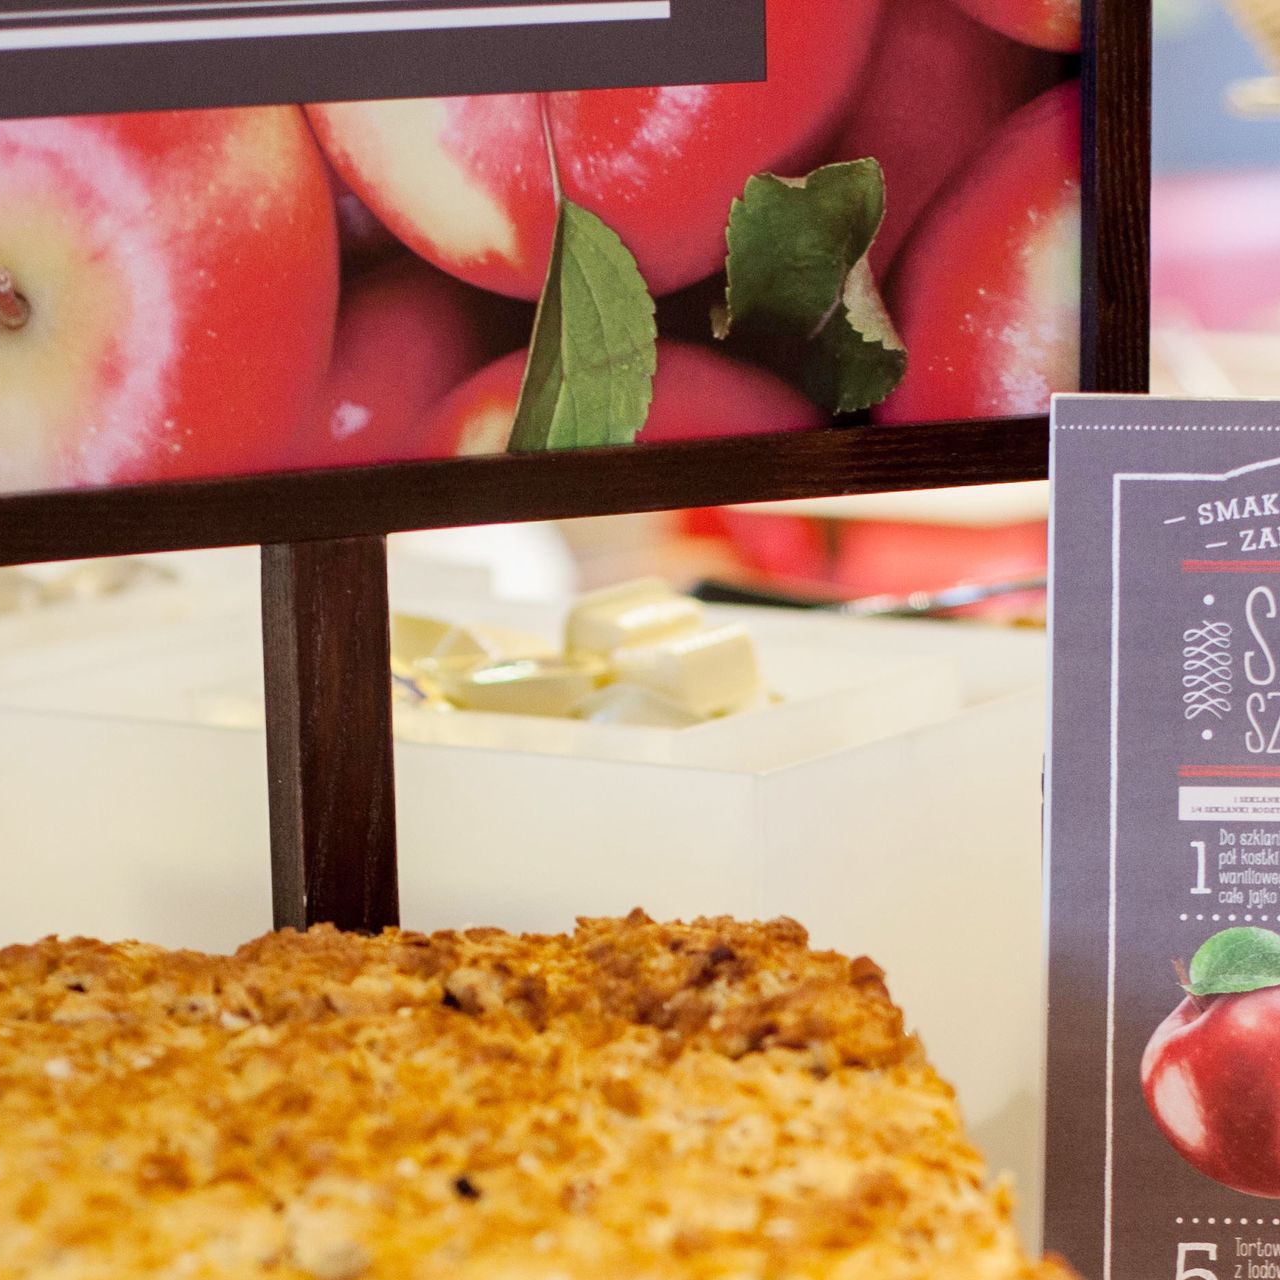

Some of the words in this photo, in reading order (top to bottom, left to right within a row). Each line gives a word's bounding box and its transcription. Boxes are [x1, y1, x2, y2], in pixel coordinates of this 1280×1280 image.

[1219, 828, 1235, 846] Do
[1190, 841, 1212, 894] 1
[1219, 848, 1237, 869] pół
[1240, 848, 1279, 866] kostki
[1219, 887, 1244, 904] całe
[1246, 887, 1277, 909] jajko
[1234, 1264, 1242, 1279] z
